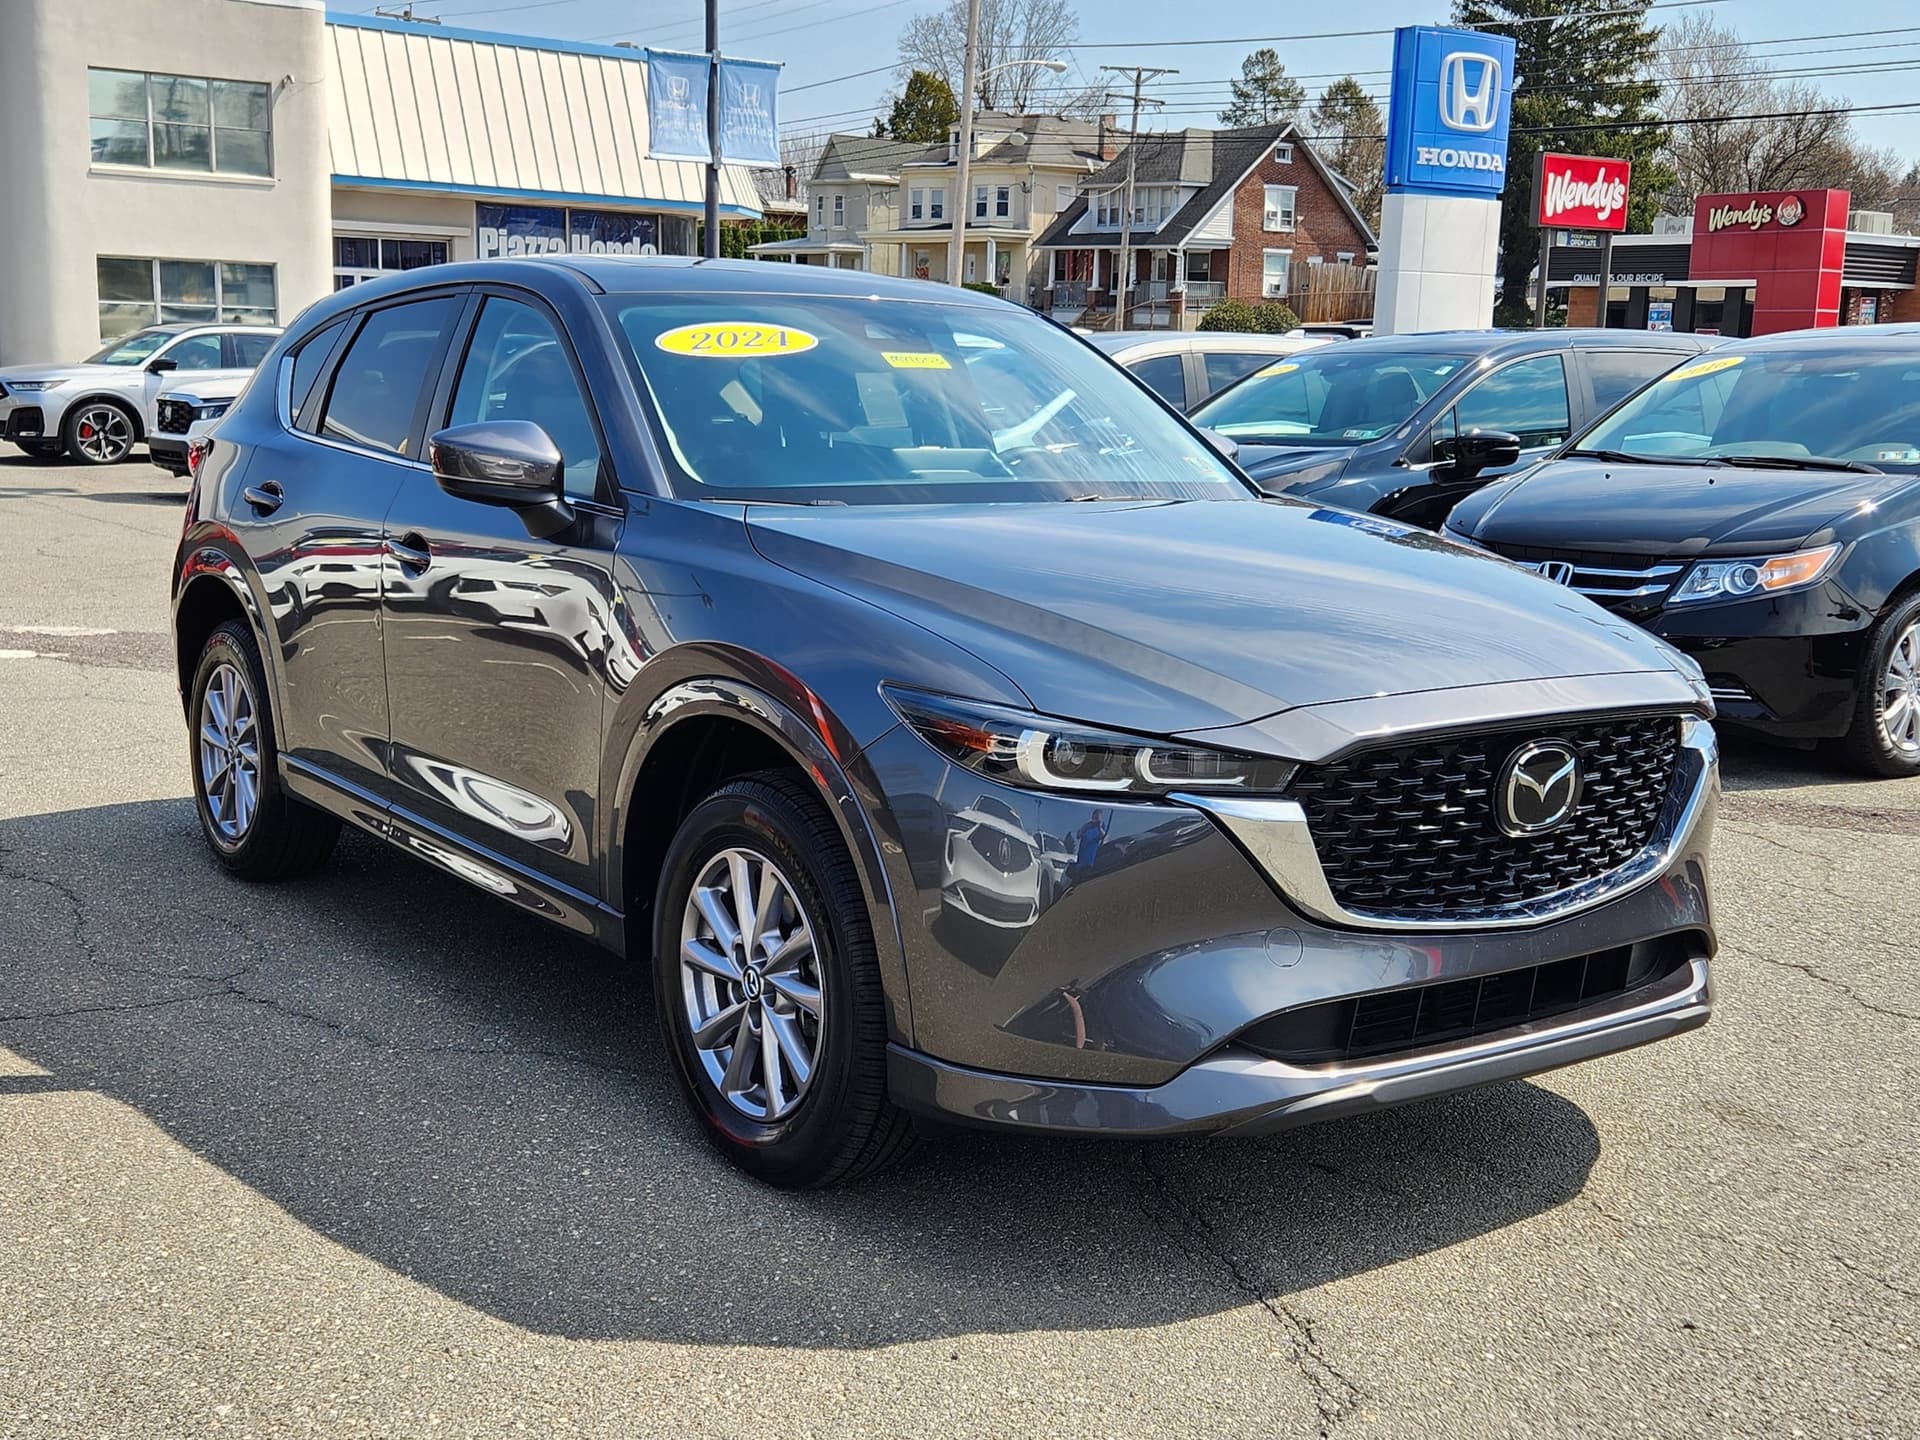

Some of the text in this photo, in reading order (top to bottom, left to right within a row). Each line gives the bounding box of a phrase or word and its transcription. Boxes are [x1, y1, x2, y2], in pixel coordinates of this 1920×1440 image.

[1416, 147, 1504, 172] HONDA
[1545, 167, 1626, 221] Wendy's
[1709, 200, 1773, 232] Wendy's
[479, 227, 566, 259] Piazza
[1573, 273, 1600, 282] QUALIT
[1616, 273, 1635, 281] OUR
[1635, 273, 1664, 281] RECIPE
[690, 330, 792, 350] 2024
